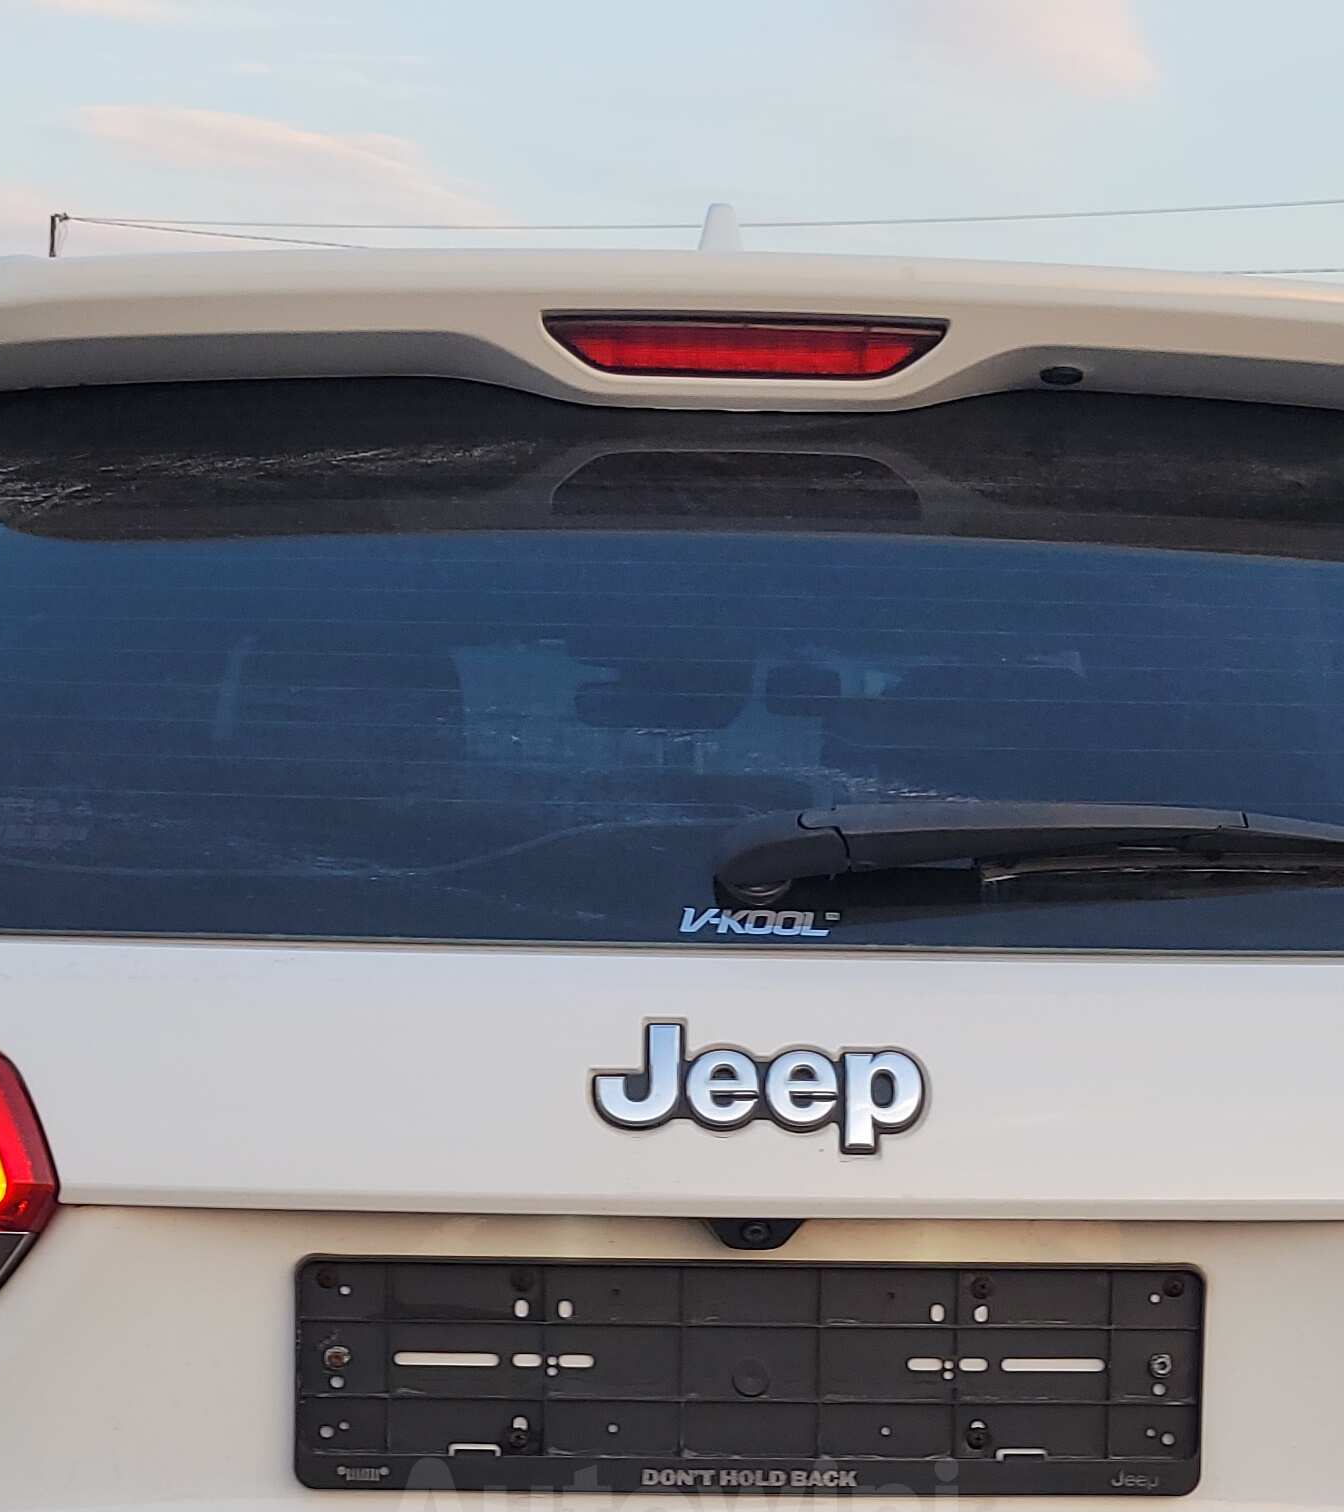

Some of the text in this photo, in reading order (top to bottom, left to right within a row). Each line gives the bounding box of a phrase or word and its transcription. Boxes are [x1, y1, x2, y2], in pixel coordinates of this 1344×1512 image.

[592, 1018, 927, 1156] Jeep
[641, 1468, 857, 1488] DON'T HOLD BACK
[1111, 1468, 1159, 1491] Jeep
